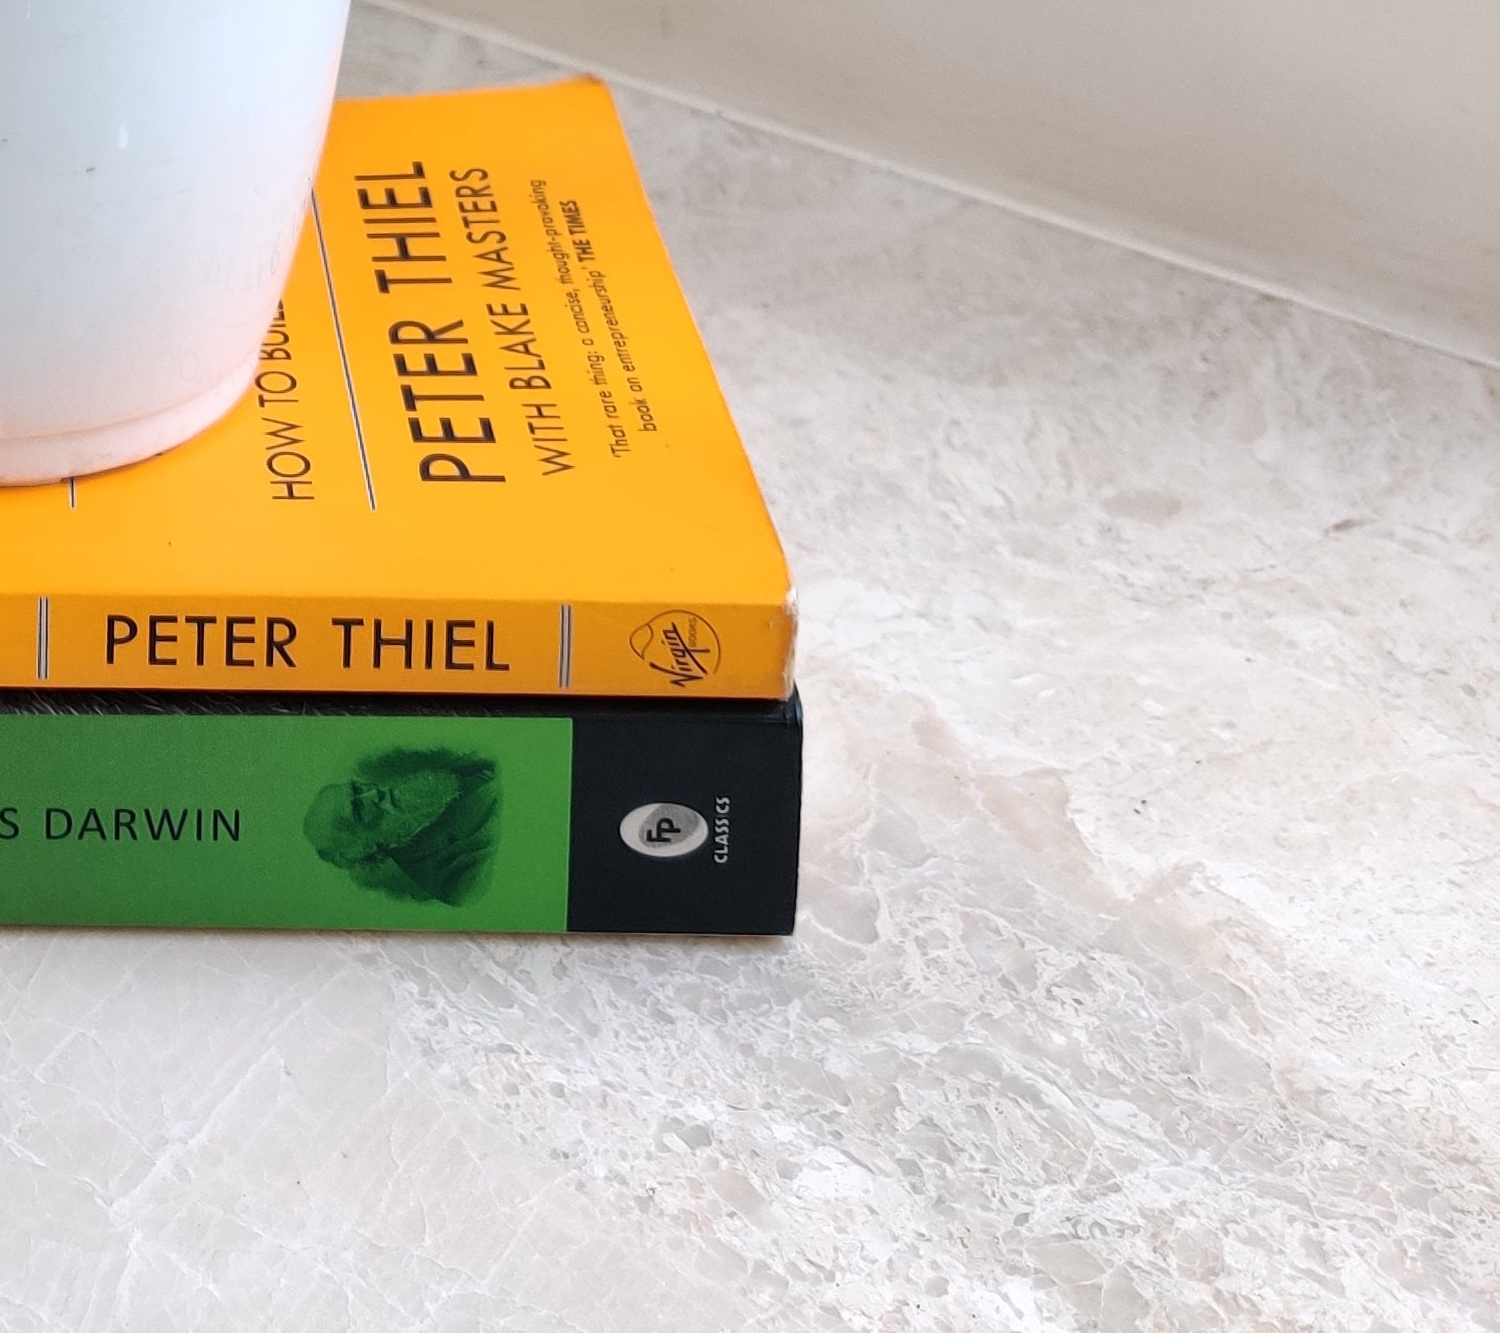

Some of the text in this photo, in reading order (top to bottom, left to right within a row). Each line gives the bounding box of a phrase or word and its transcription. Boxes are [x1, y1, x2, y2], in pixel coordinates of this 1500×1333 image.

[529, 179, 574, 285] thought-provoking
[559, 199, 588, 236] TIMES
[572, 238, 597, 263] THE
[354, 161, 506, 483] PETER THIEL
[450, 168, 575, 476] WITH BLAKE MASTERS
[565, 288, 590, 334] concise,
[582, 338, 595, 346] a
[587, 351, 608, 385] thing:
[627, 377, 643, 393] on
[254, 370, 299, 408] TO
[599, 390, 620, 419] rare
[628, 397, 657, 432] book
[261, 417, 315, 500] HOW
[104, 614, 511, 673] PETER THIEL
[648, 622, 710, 687] Virgin
[45, 807, 240, 842] DARWIN
[713, 796, 731, 864] CLASSICS
